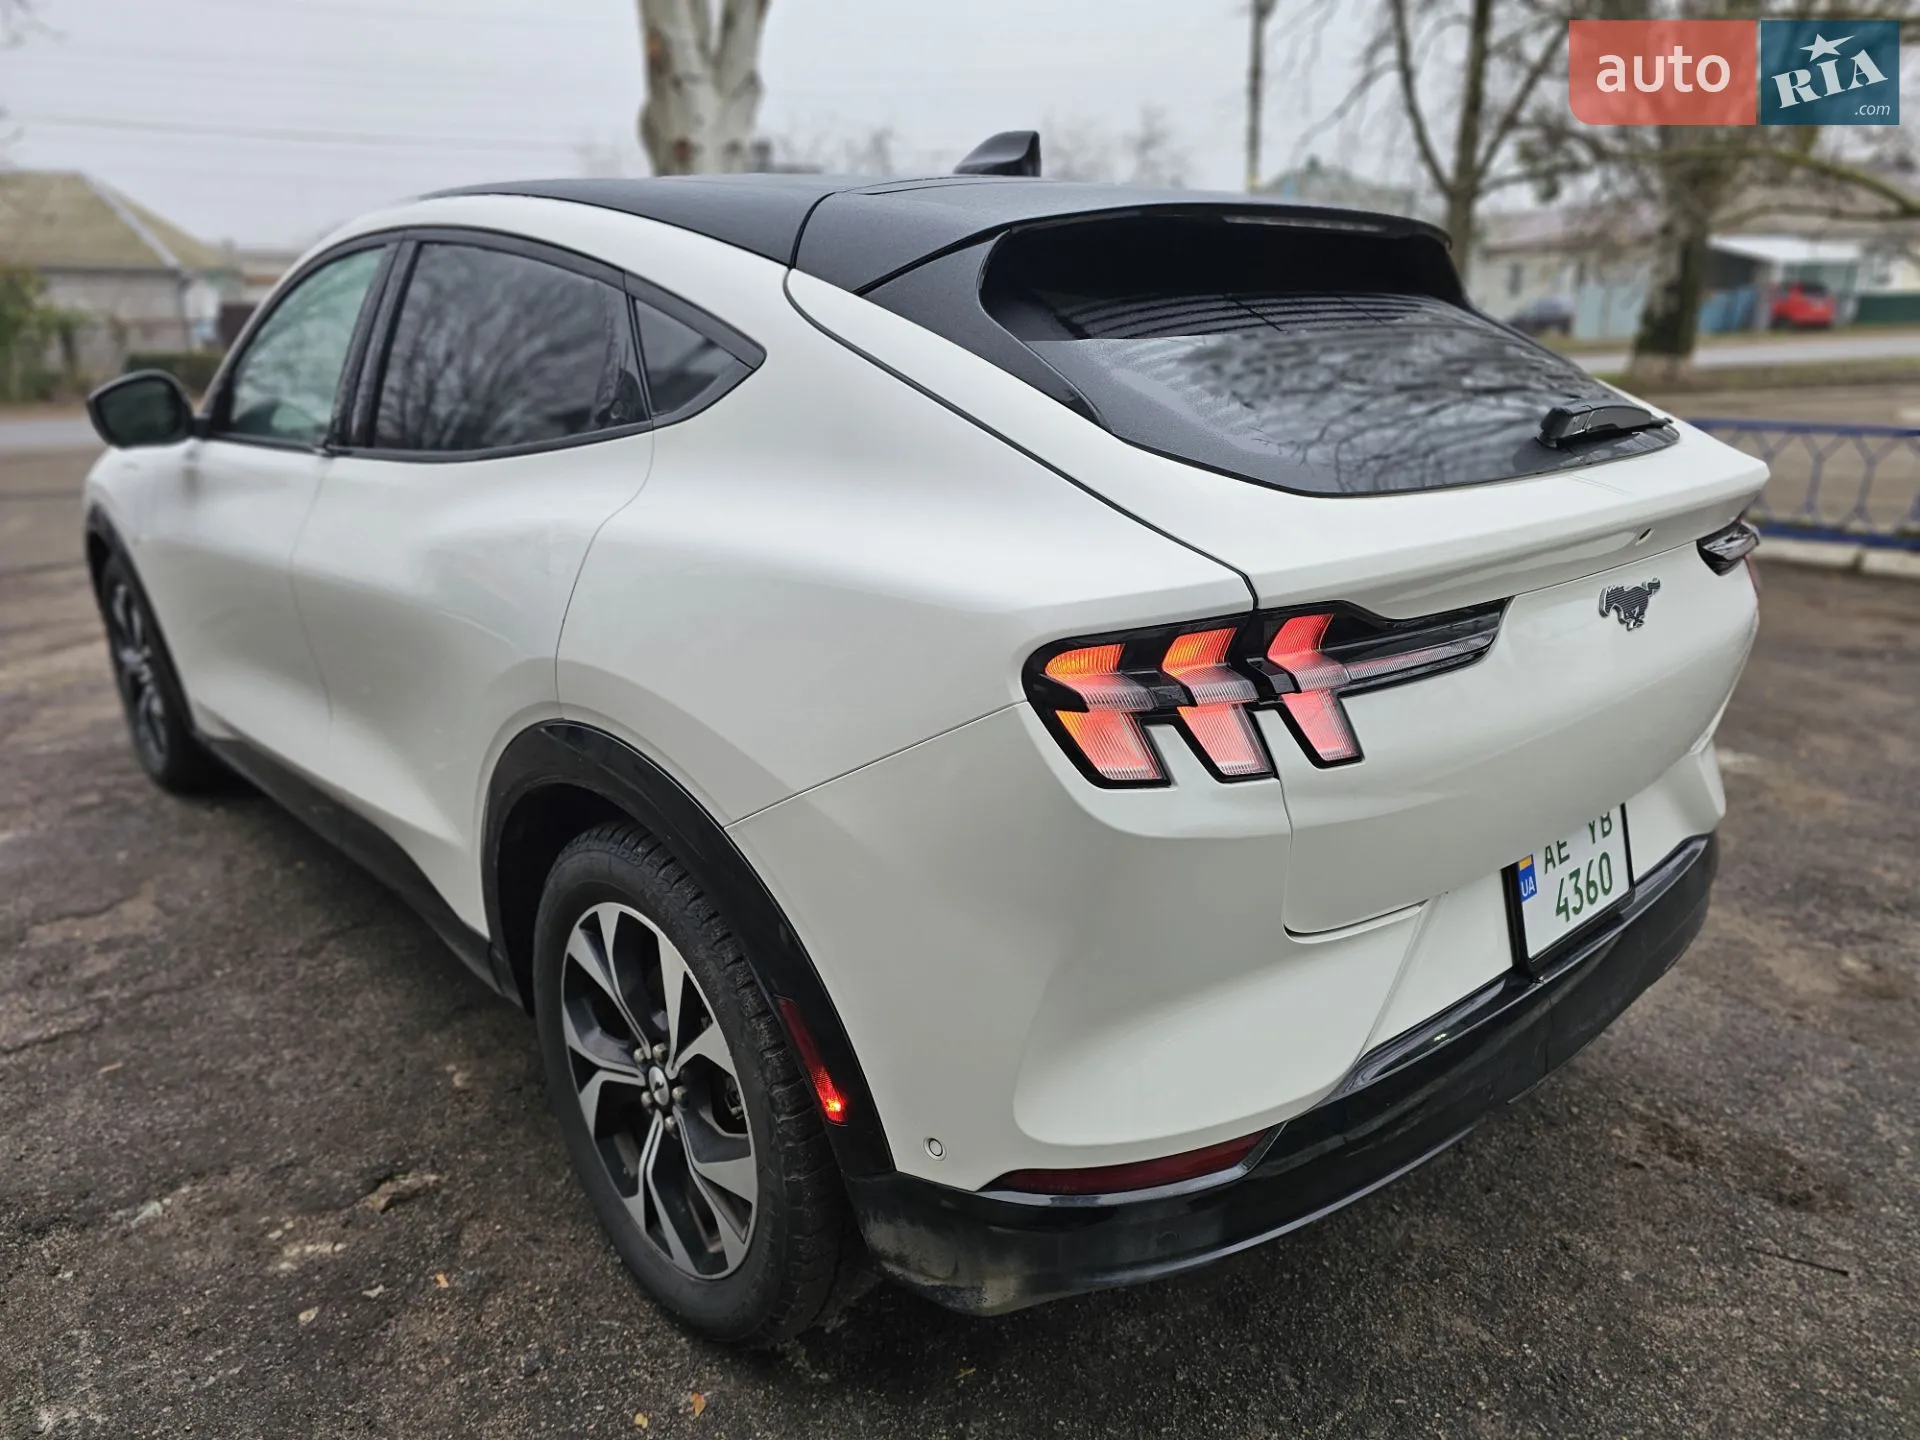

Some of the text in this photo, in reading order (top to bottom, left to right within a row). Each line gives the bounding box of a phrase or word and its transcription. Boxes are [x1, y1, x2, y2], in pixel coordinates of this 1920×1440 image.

[1544, 840, 1570, 875] AE
[1521, 877, 1536, 897] UA
[1555, 851, 1613, 923] 4360
